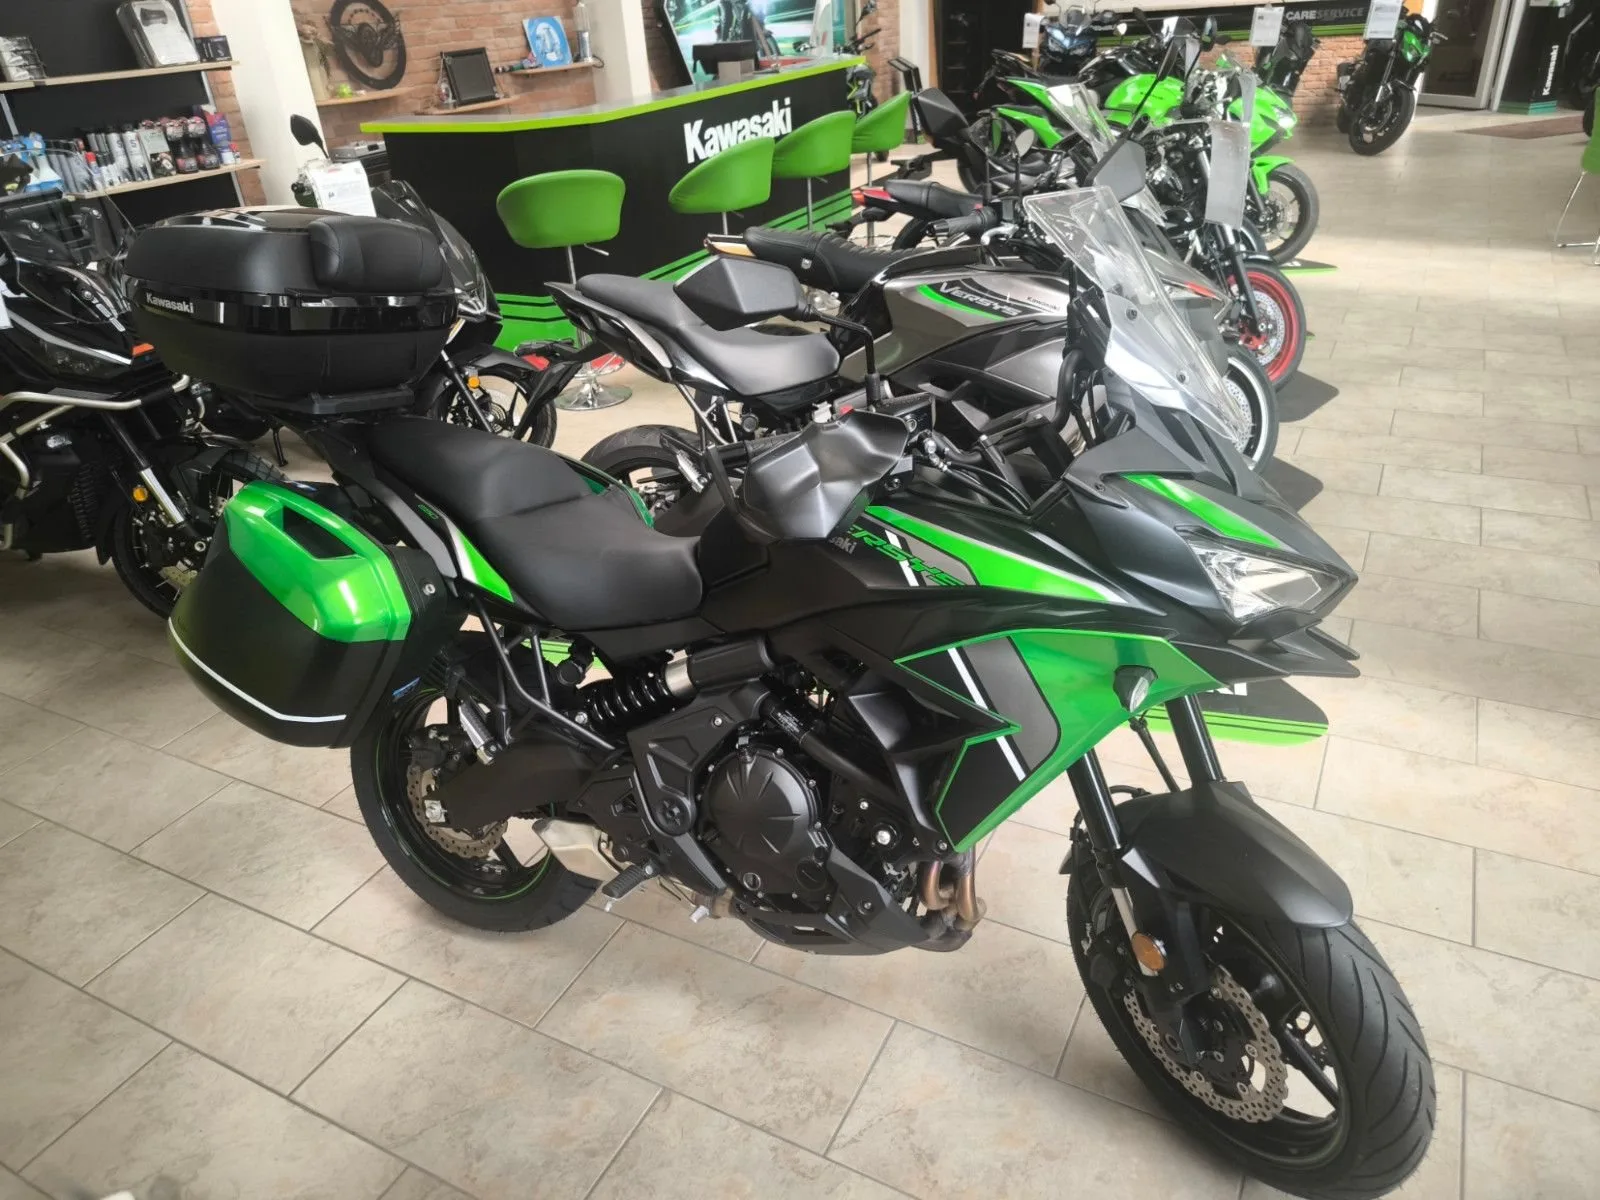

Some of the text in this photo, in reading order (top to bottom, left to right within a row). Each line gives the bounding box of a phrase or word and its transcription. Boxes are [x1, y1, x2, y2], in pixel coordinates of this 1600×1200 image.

[1542, 44, 1560, 96] Kawasaki
[683, 96, 793, 164] Kawasaki
[145, 291, 194, 314] Kawasaki
